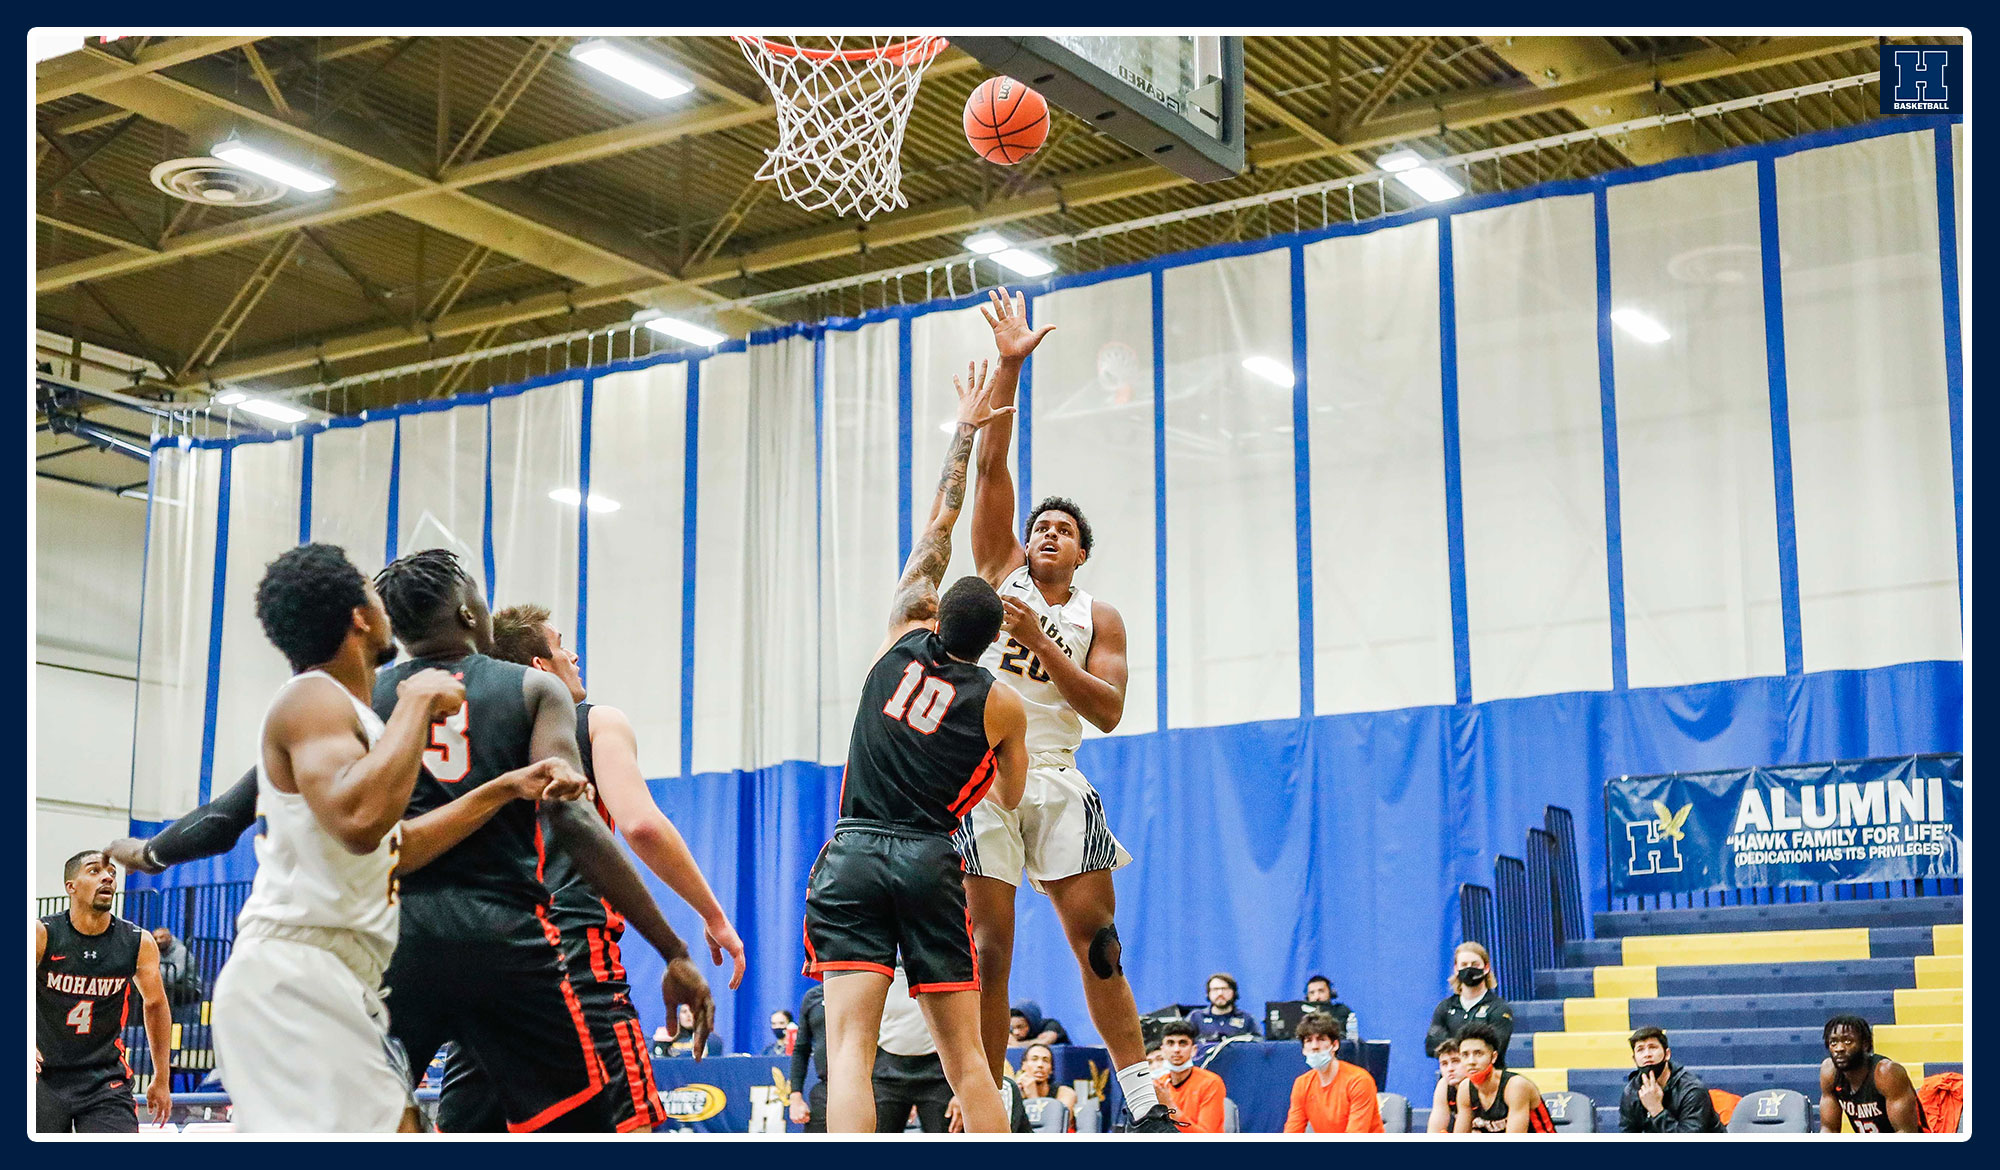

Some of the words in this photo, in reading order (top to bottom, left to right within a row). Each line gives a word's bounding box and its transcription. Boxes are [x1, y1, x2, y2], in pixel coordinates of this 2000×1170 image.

[882, 659, 957, 736] 10
[422, 699, 472, 784] 3
[1734, 777, 1945, 833] ALUMNI
[1625, 821, 1684, 876] H
[1734, 850, 1812, 868] (DEDICATION
[1816, 847, 1842, 862] HAS
[1845, 846, 1866, 861] ITS
[1869, 842, 1945, 860] PRIVILEGES)
[1792, 829, 1858, 848] FAMILY
[1862, 827, 1899, 845] FOR
[46, 972, 127, 997] MOHAWK
[66, 999, 95, 1035] 4
[1838, 1099, 1883, 1119] MOAWK
